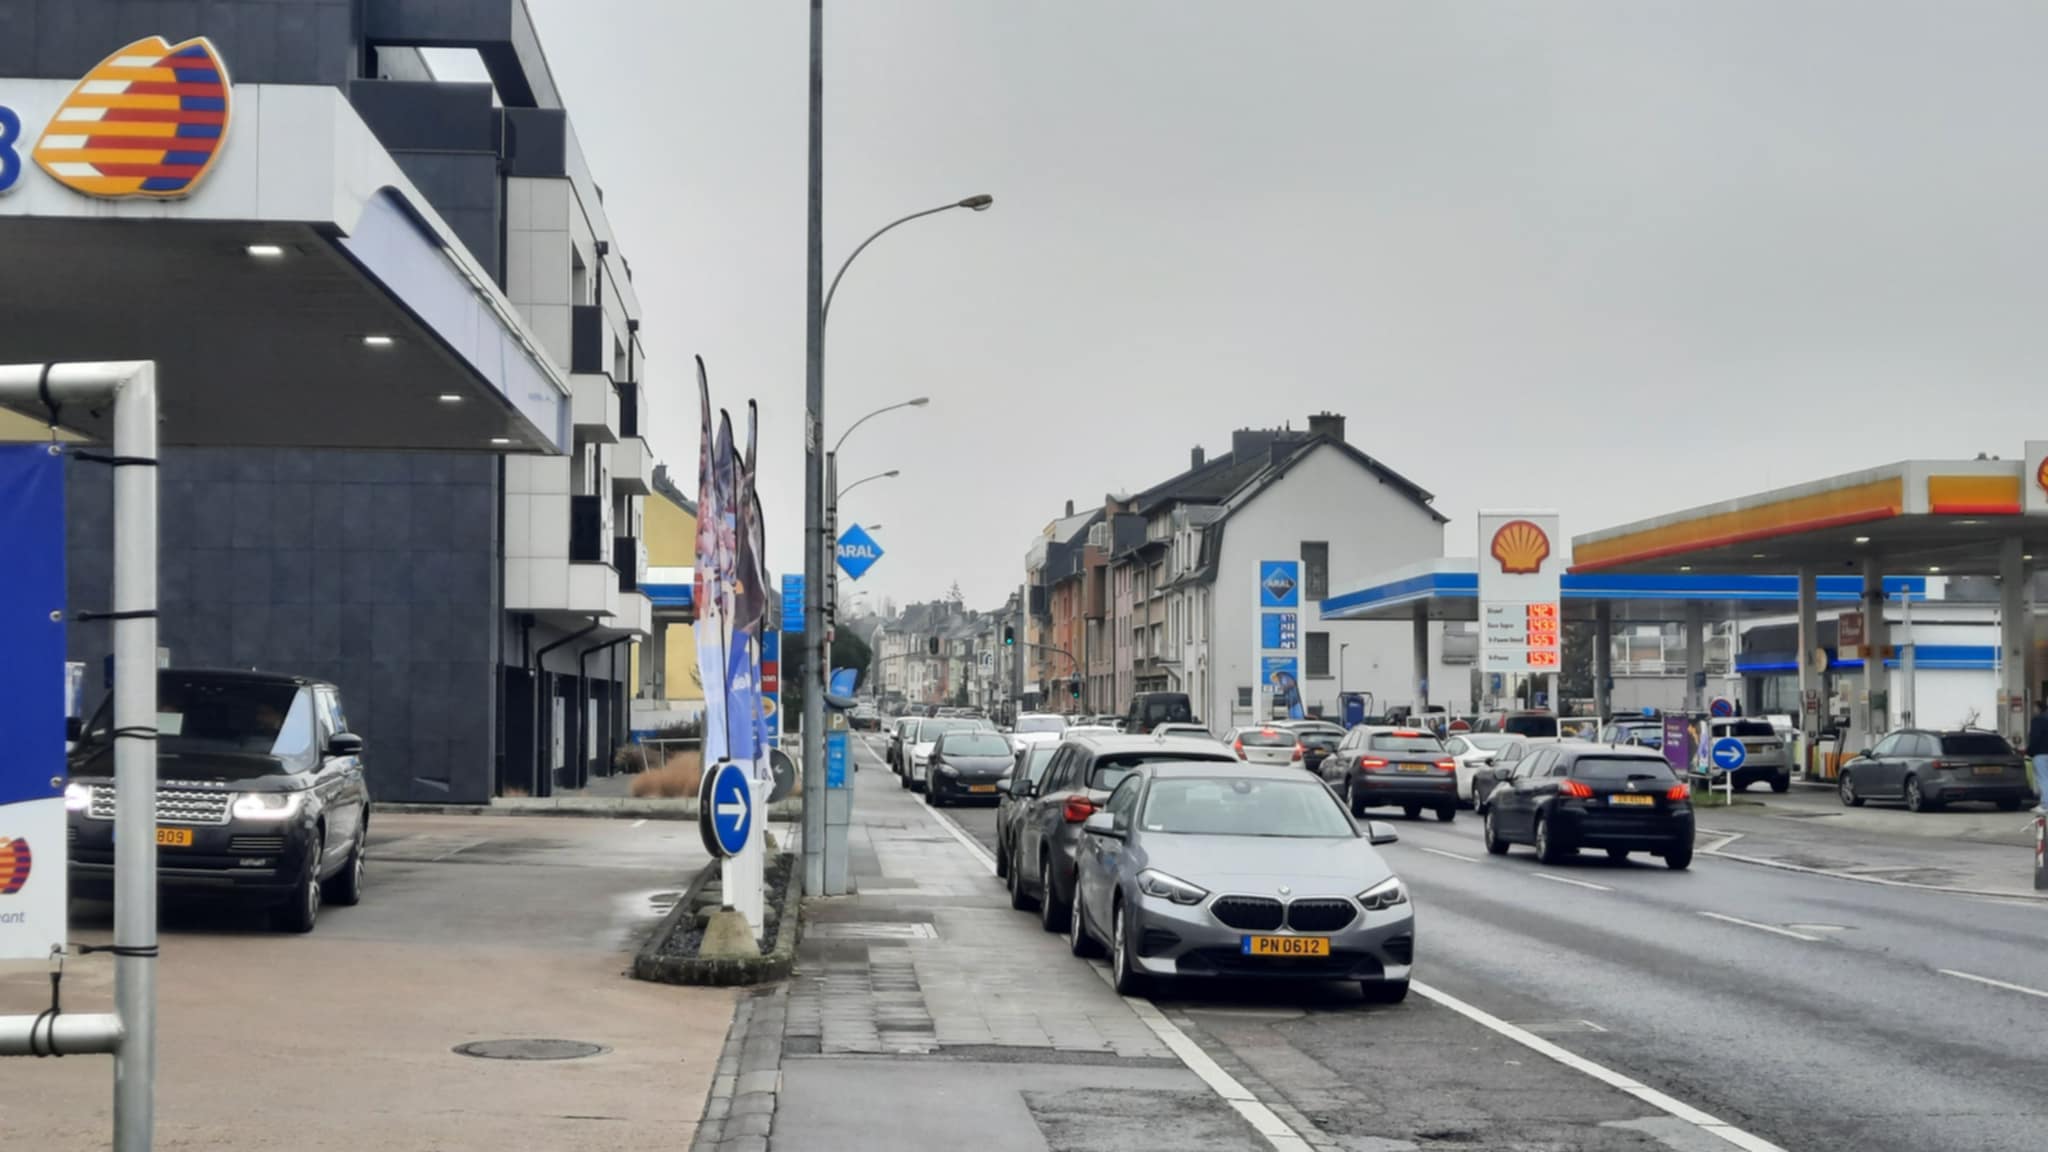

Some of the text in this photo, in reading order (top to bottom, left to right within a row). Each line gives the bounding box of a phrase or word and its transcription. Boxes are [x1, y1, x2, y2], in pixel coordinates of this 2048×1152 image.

[837, 544, 876, 558] ARAL
[832, 713, 844, 729] P
[1260, 938, 1320, 953] PN 0612
